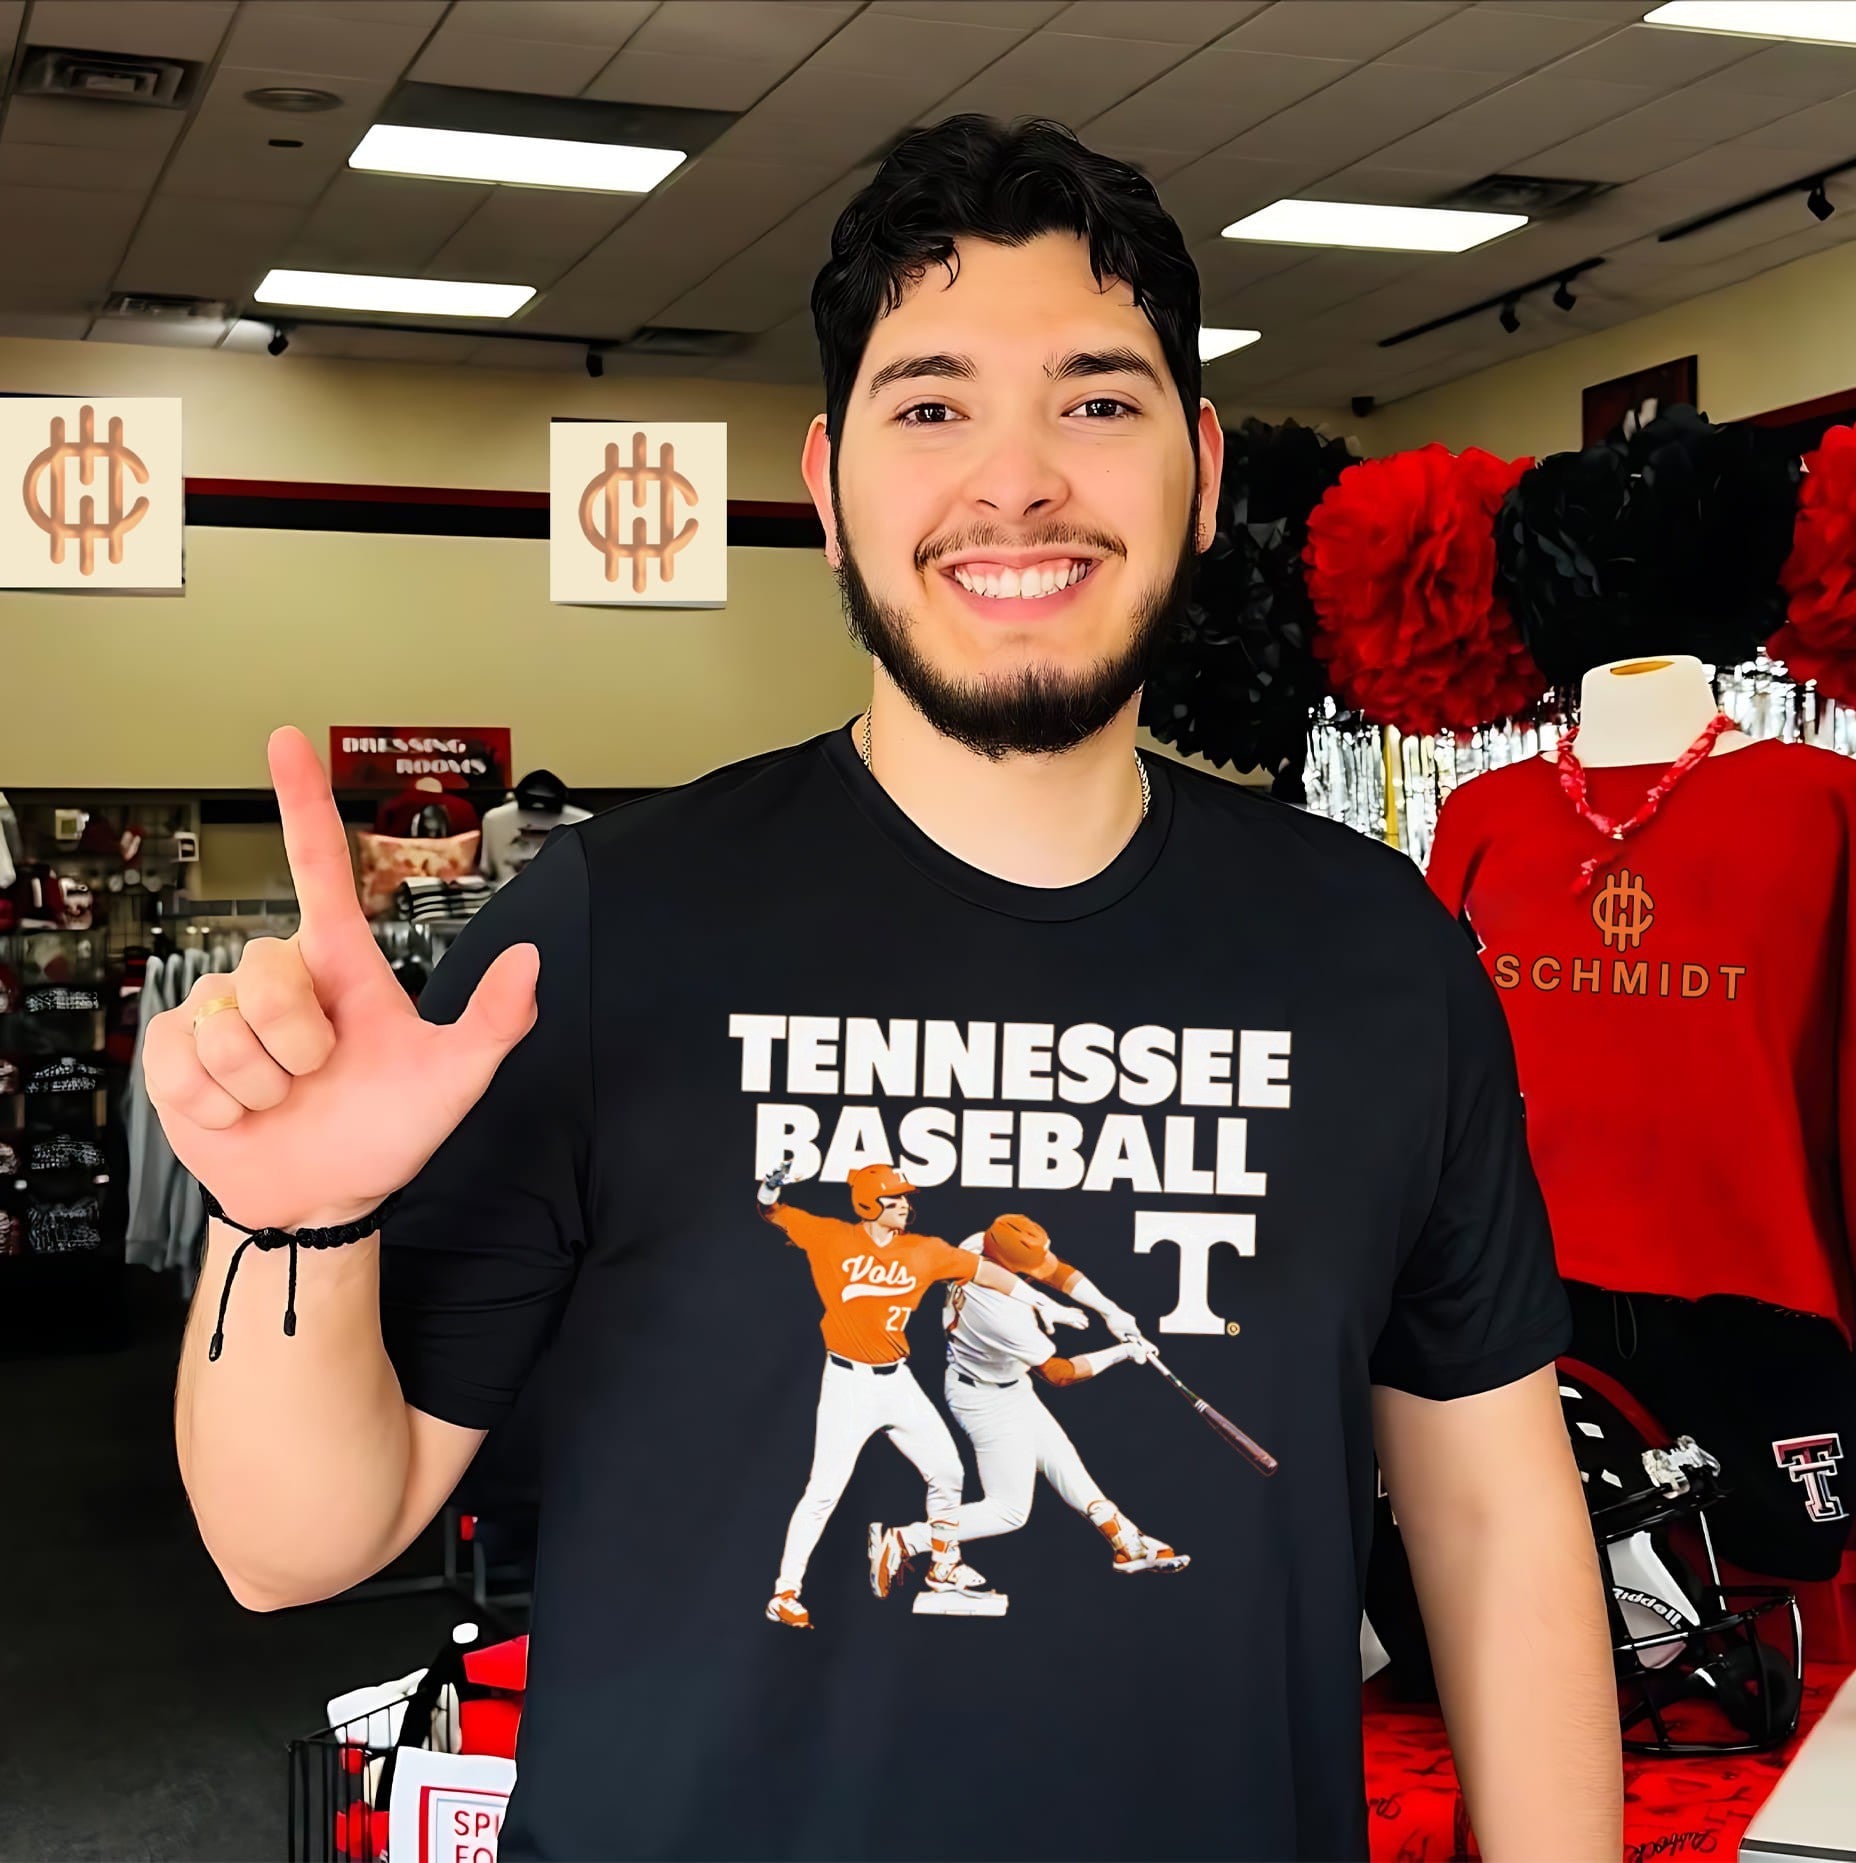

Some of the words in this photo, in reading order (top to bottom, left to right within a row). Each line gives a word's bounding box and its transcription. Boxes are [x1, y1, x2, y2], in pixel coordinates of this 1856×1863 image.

[342, 737, 467, 754] DRESSING
[396, 758, 487, 775] ROOMS
[1494, 954, 1747, 1000] SCHMIDT
[728, 1013, 1292, 1109] TENNESSEE
[755, 1102, 1268, 1196] BASEBALL
[842, 1254, 917, 1286] Vols
[1133, 1210, 1256, 1335] T
[885, 1305, 912, 1332] 27
